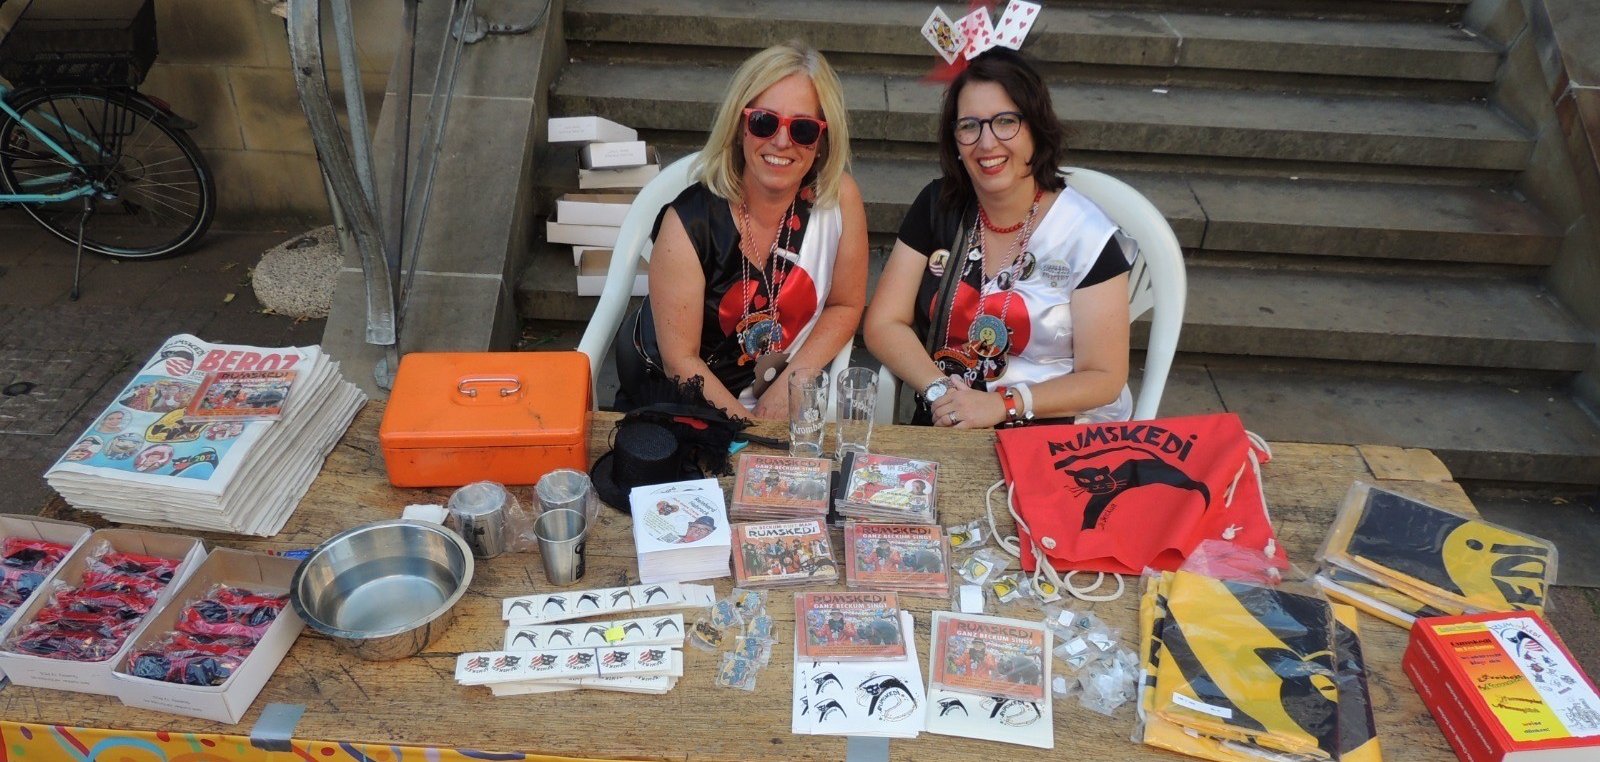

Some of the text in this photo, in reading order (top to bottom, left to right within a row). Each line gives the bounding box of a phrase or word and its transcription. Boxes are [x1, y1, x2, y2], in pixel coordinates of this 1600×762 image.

[862, 526, 931, 534] RUMSKEDI
[813, 594, 887, 603] RUMSKEDI
[957, 622, 1033, 639] RUMSKEDI
[956, 630, 977, 638] GANZ
[980, 633, 1009, 642] BECKUM
